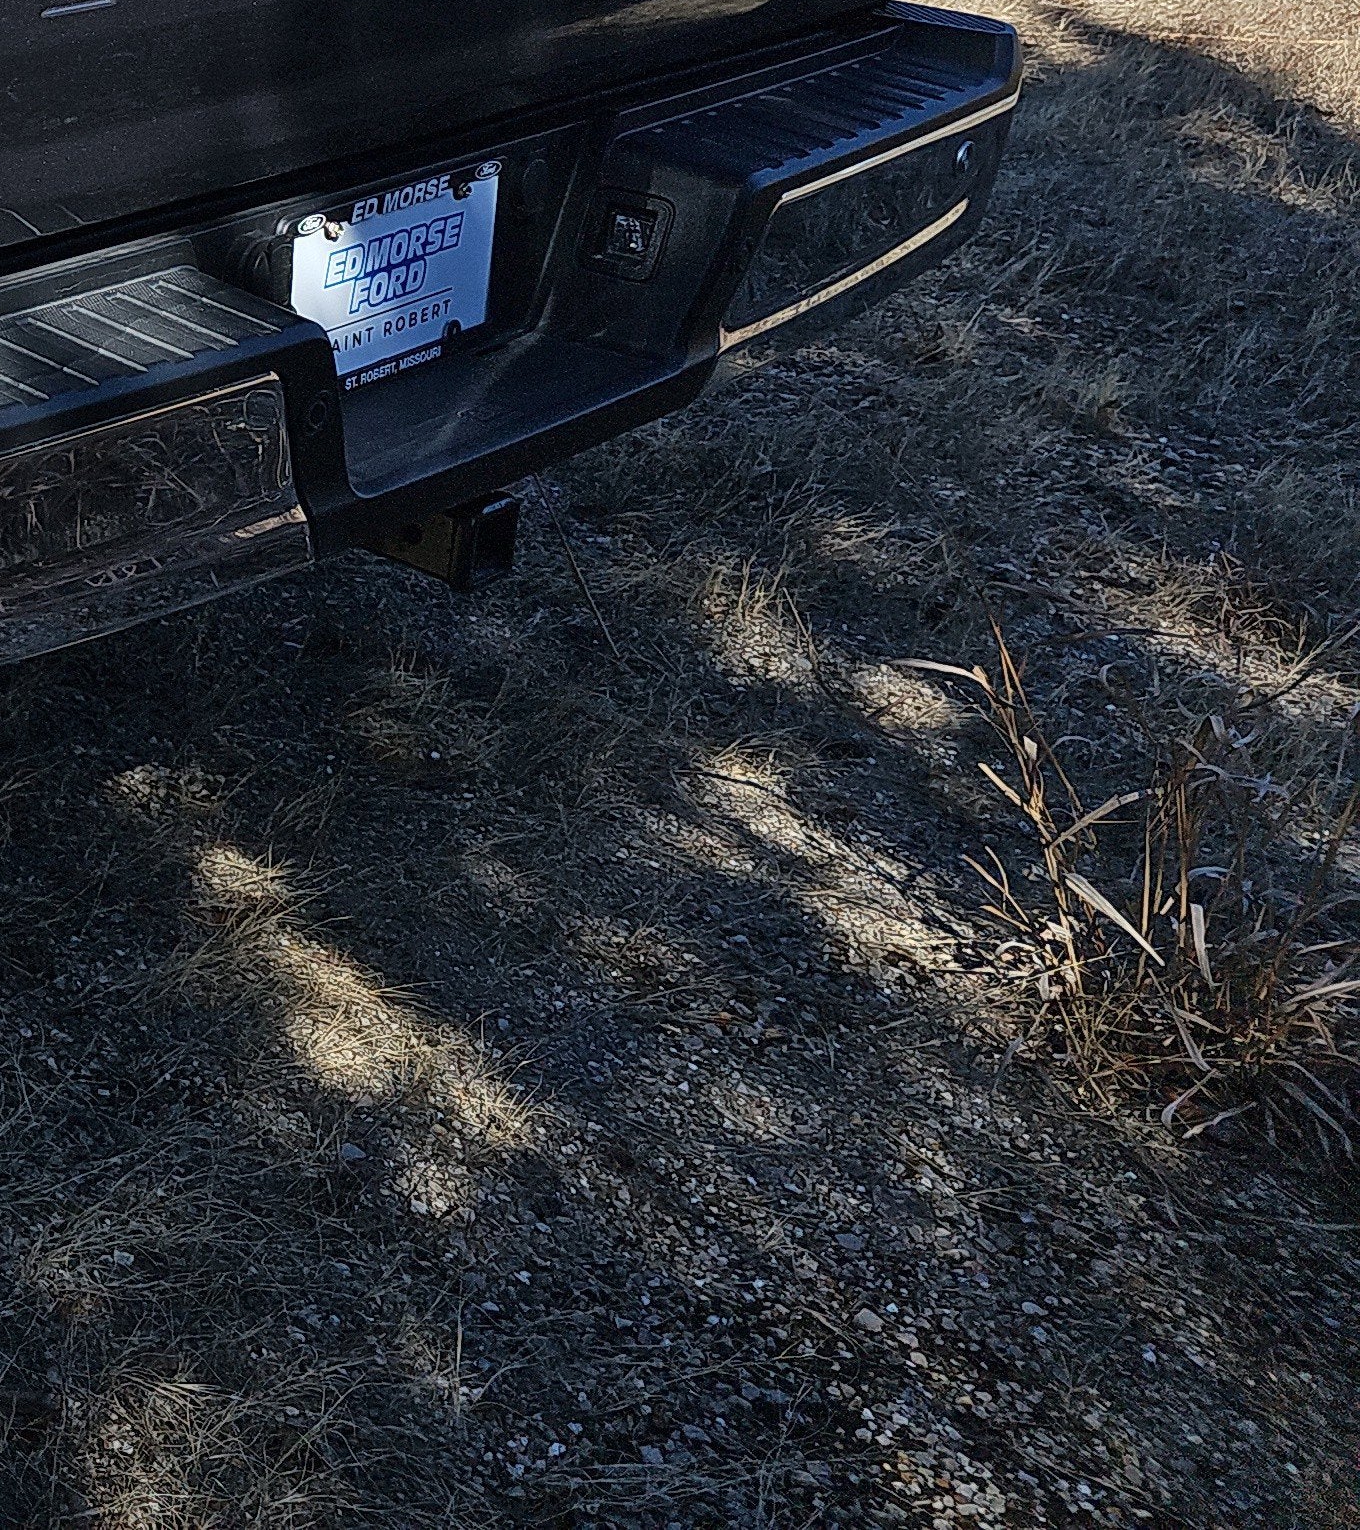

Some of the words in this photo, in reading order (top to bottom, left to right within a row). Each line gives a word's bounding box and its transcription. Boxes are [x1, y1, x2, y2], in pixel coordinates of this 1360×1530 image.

[351, 200, 378, 223] ED
[382, 174, 451, 215] MORSE
[324, 243, 367, 288] ED
[364, 211, 465, 274] MORSE
[349, 259, 428, 315] FORD
[332, 326, 375, 354] AINT
[383, 299, 452, 338] ROBERT
[344, 374, 359, 391] ST.
[399, 345, 442, 373] MISSOURI
